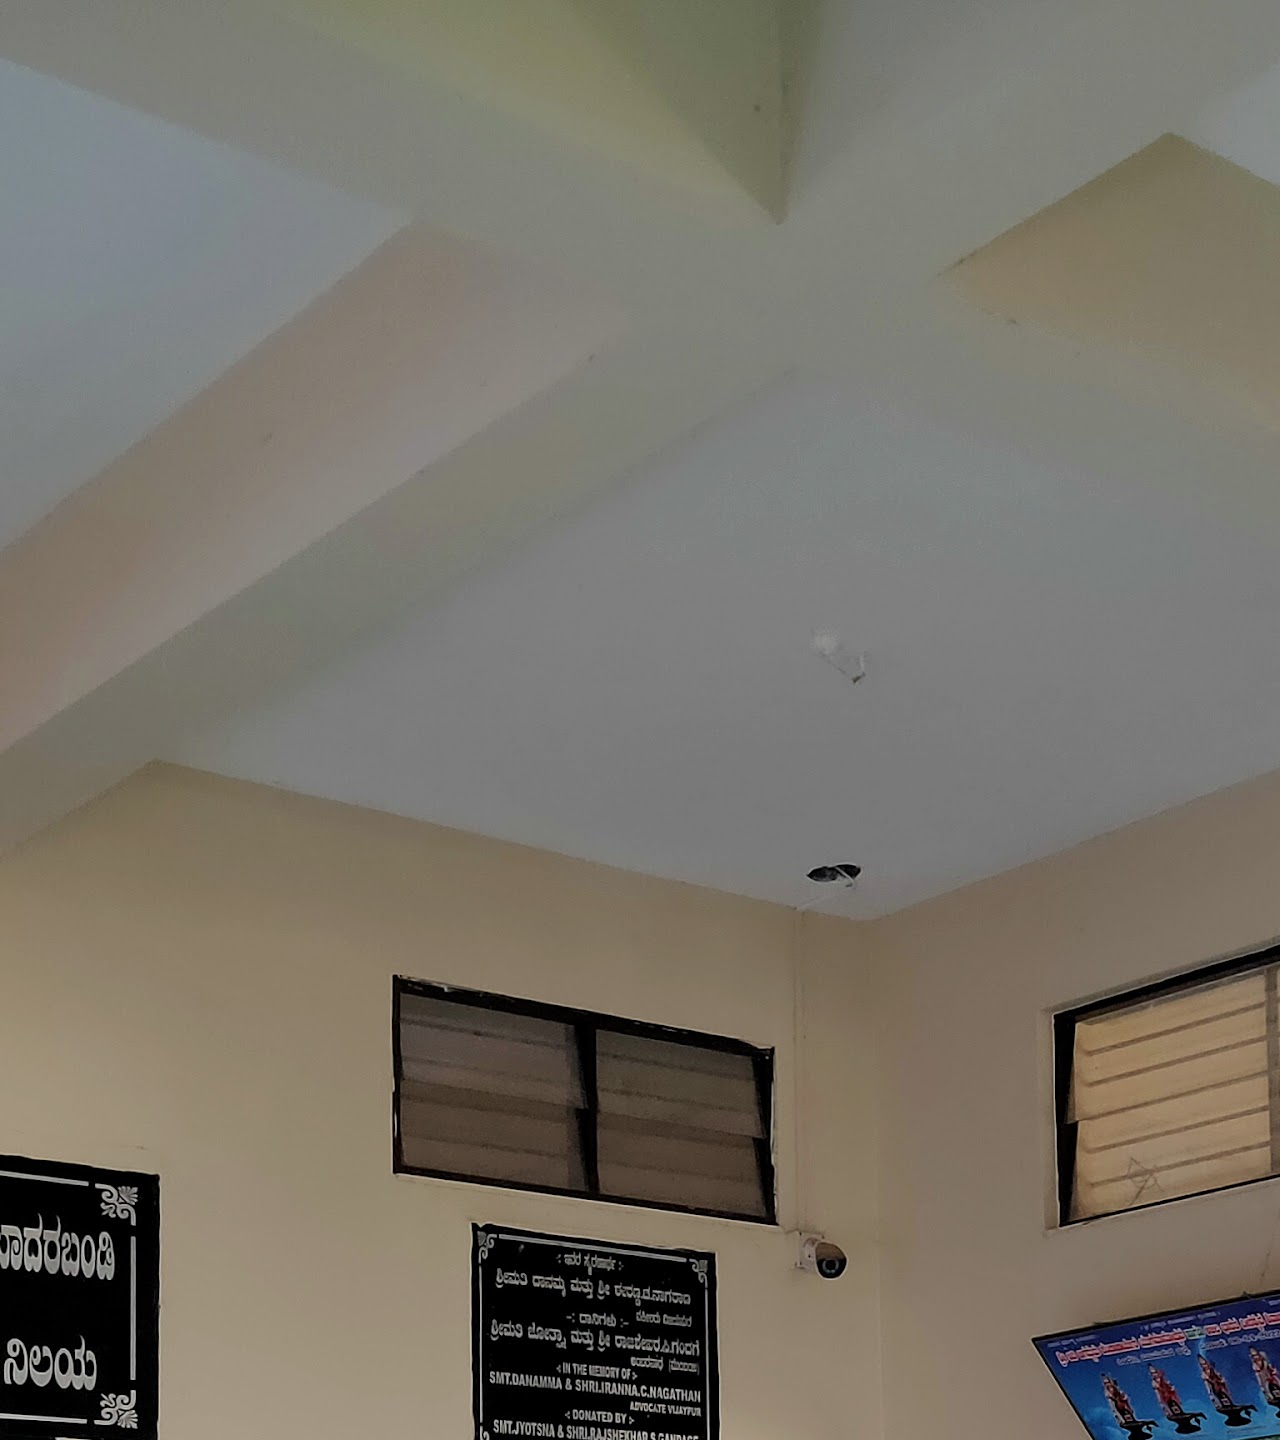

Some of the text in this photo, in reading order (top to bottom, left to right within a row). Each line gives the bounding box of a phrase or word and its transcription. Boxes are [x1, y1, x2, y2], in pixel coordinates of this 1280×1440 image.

[495, 1268, 527, 1288] ಶ್ರೀಮತಿ
[532, 1275, 566, 1297] ದಾನಮ್ಮ
[570, 1278, 593, 1299] ಮತ್ತು
[597, 1280, 610, 1299] ಶ್ರೀ
[490, 1319, 523, 1341] ಶ್ರೀಮತಿ
[571, 1330, 594, 1351] ಮತ್ತು
[598, 1330, 610, 1351] ಶ್ರೀ
[4, 1335, 97, 1391] ನಿಲಯ
[573, 1363, 587, 1376] THE
[589, 1365, 619, 1378] MEMORY
[621, 1368, 631, 1380] OF
[565, 1378, 572, 1391] &
[630, 1401, 666, 1414] ADVOCATE
[572, 1409, 627, 1424] DONATED BY
[558, 1424, 564, 1438] &
